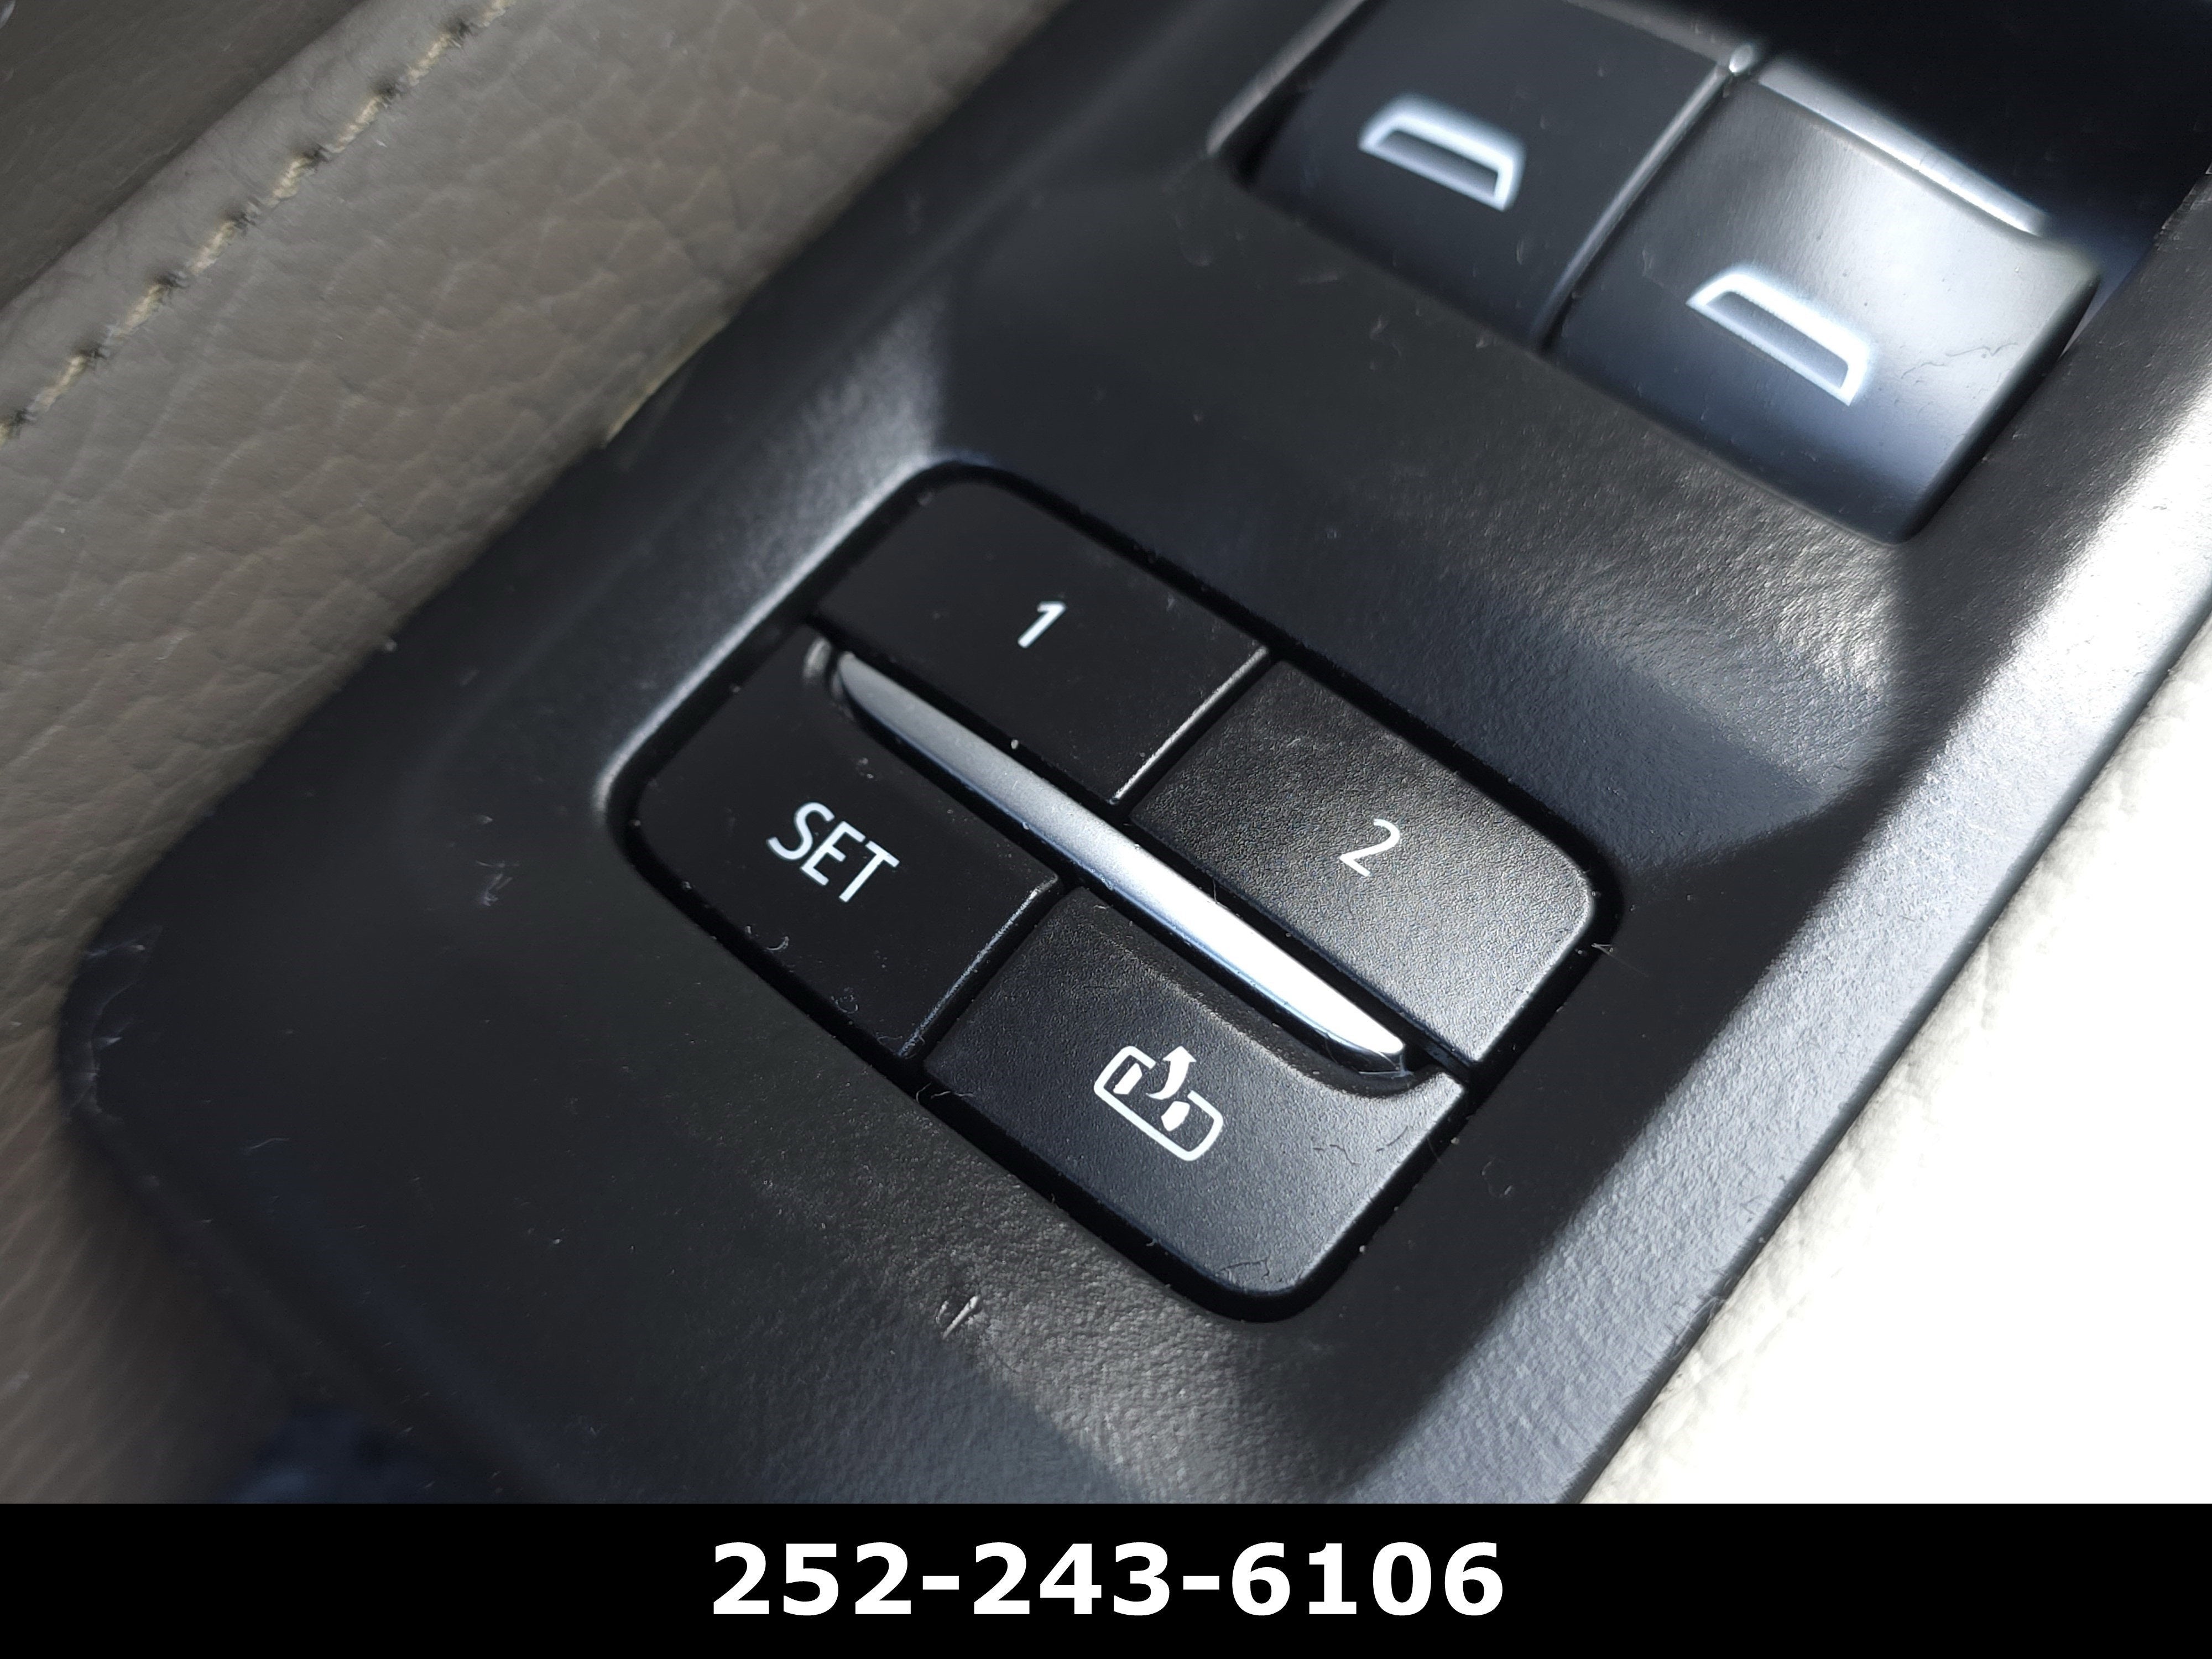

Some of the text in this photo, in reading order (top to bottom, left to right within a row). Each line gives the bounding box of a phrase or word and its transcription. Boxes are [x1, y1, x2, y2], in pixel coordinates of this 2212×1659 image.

[1018, 601, 1066, 648] 1
[766, 802, 900, 903] SET
[1339, 818, 1400, 877] 2
